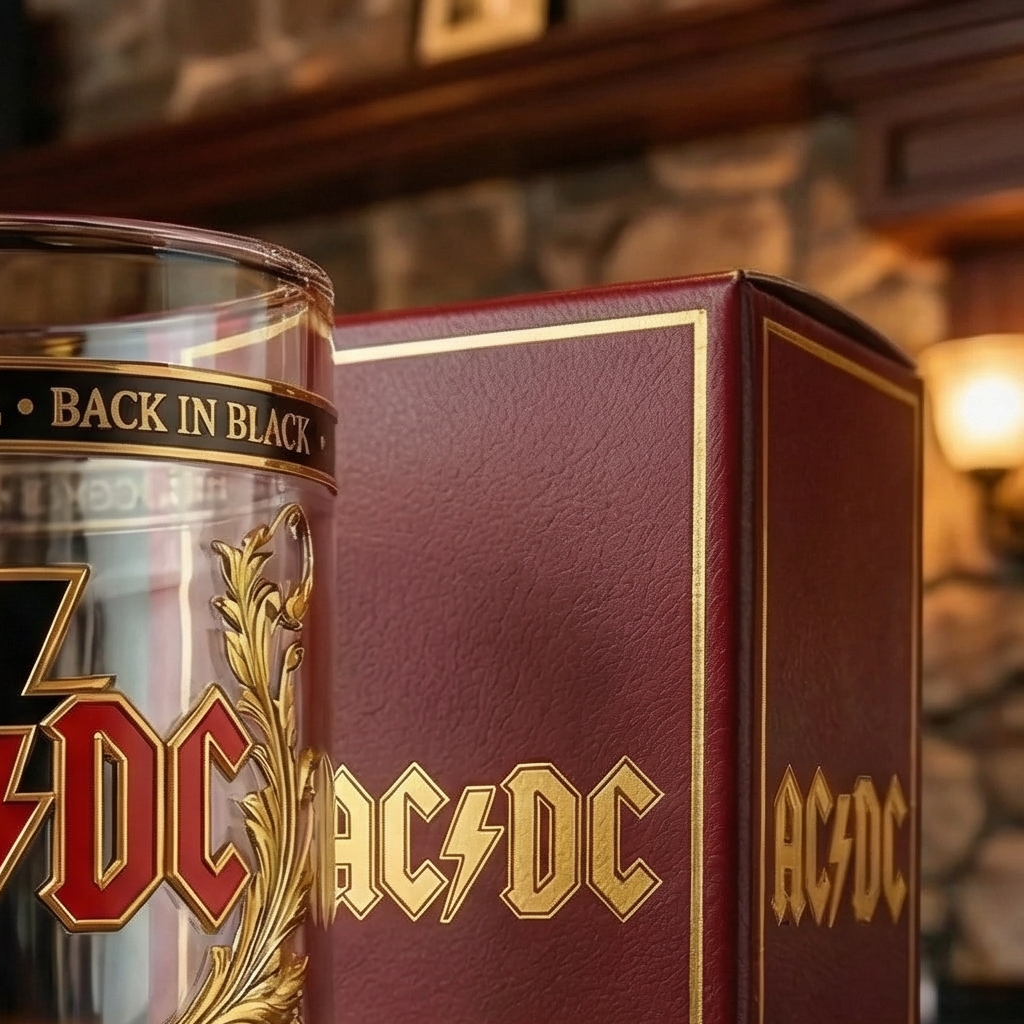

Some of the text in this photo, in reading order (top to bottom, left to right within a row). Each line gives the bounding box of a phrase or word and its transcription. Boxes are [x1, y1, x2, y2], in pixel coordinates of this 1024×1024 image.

[51, 387, 169, 434] BACK
[178, 395, 216, 437] IN
[226, 406, 310, 456] BLACK
